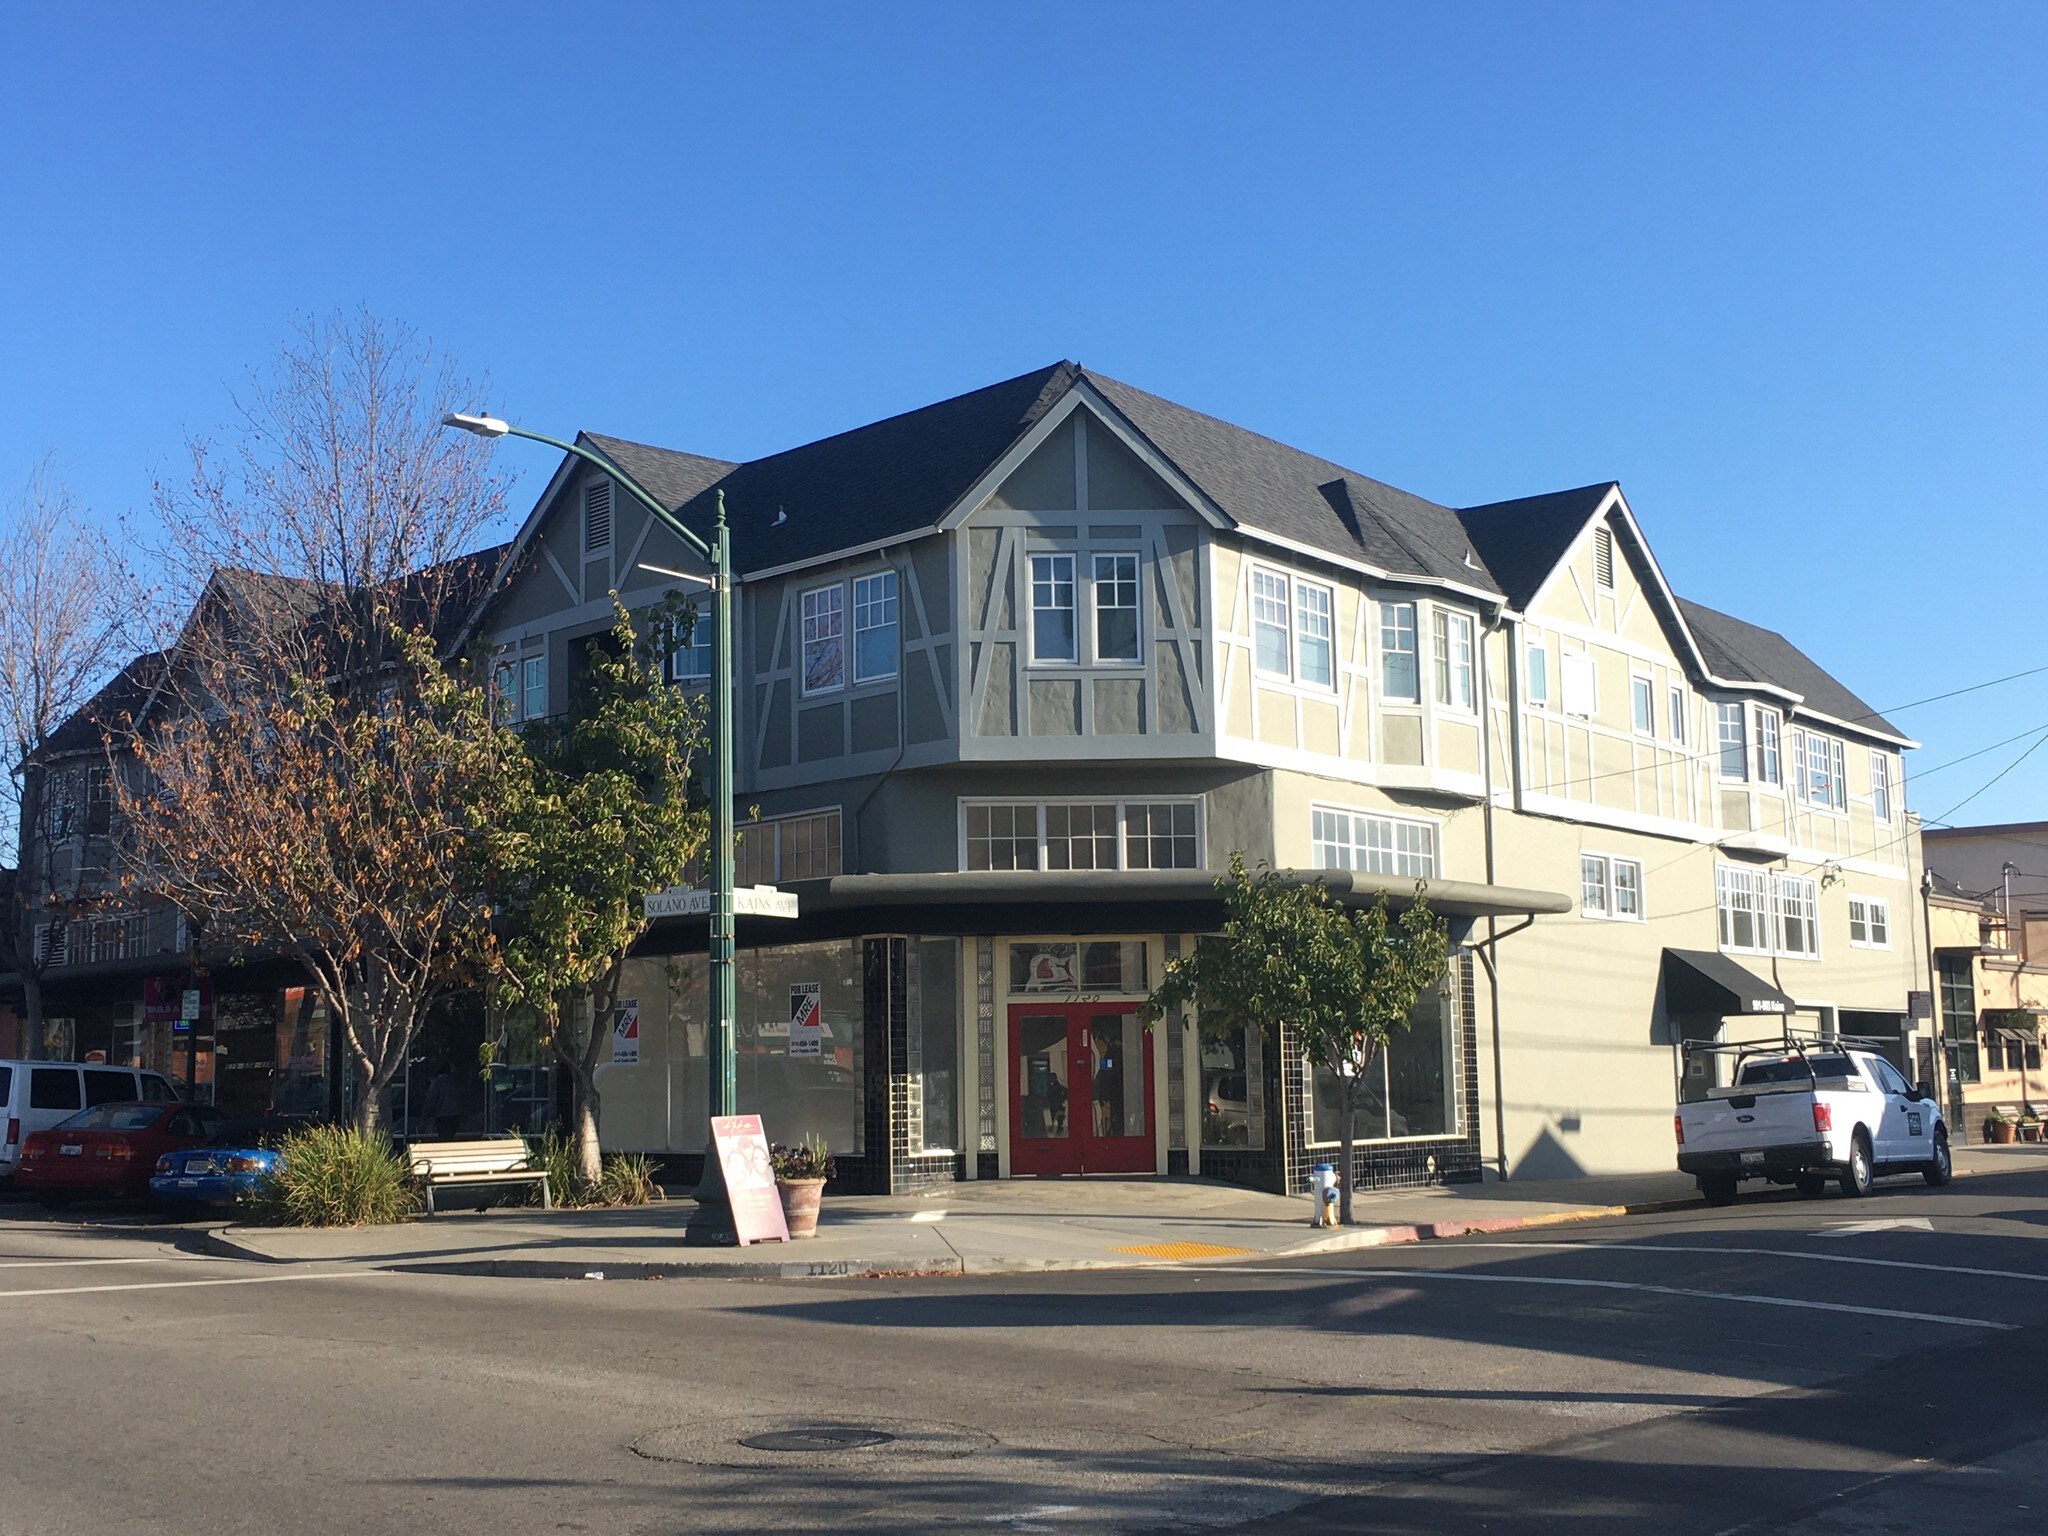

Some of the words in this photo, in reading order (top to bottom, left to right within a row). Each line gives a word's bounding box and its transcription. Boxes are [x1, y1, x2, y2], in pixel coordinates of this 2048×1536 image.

[647, 897, 686, 914] SOLANO
[737, 896, 772, 911] KAINS
[790, 985, 801, 994] FOR
[802, 983, 819, 994] LEASE
[622, 999, 638, 1009] LEASE
[796, 996, 814, 1026] MRE
[618, 1011, 633, 1038] MRE
[806, 1261, 849, 1276] 1120
